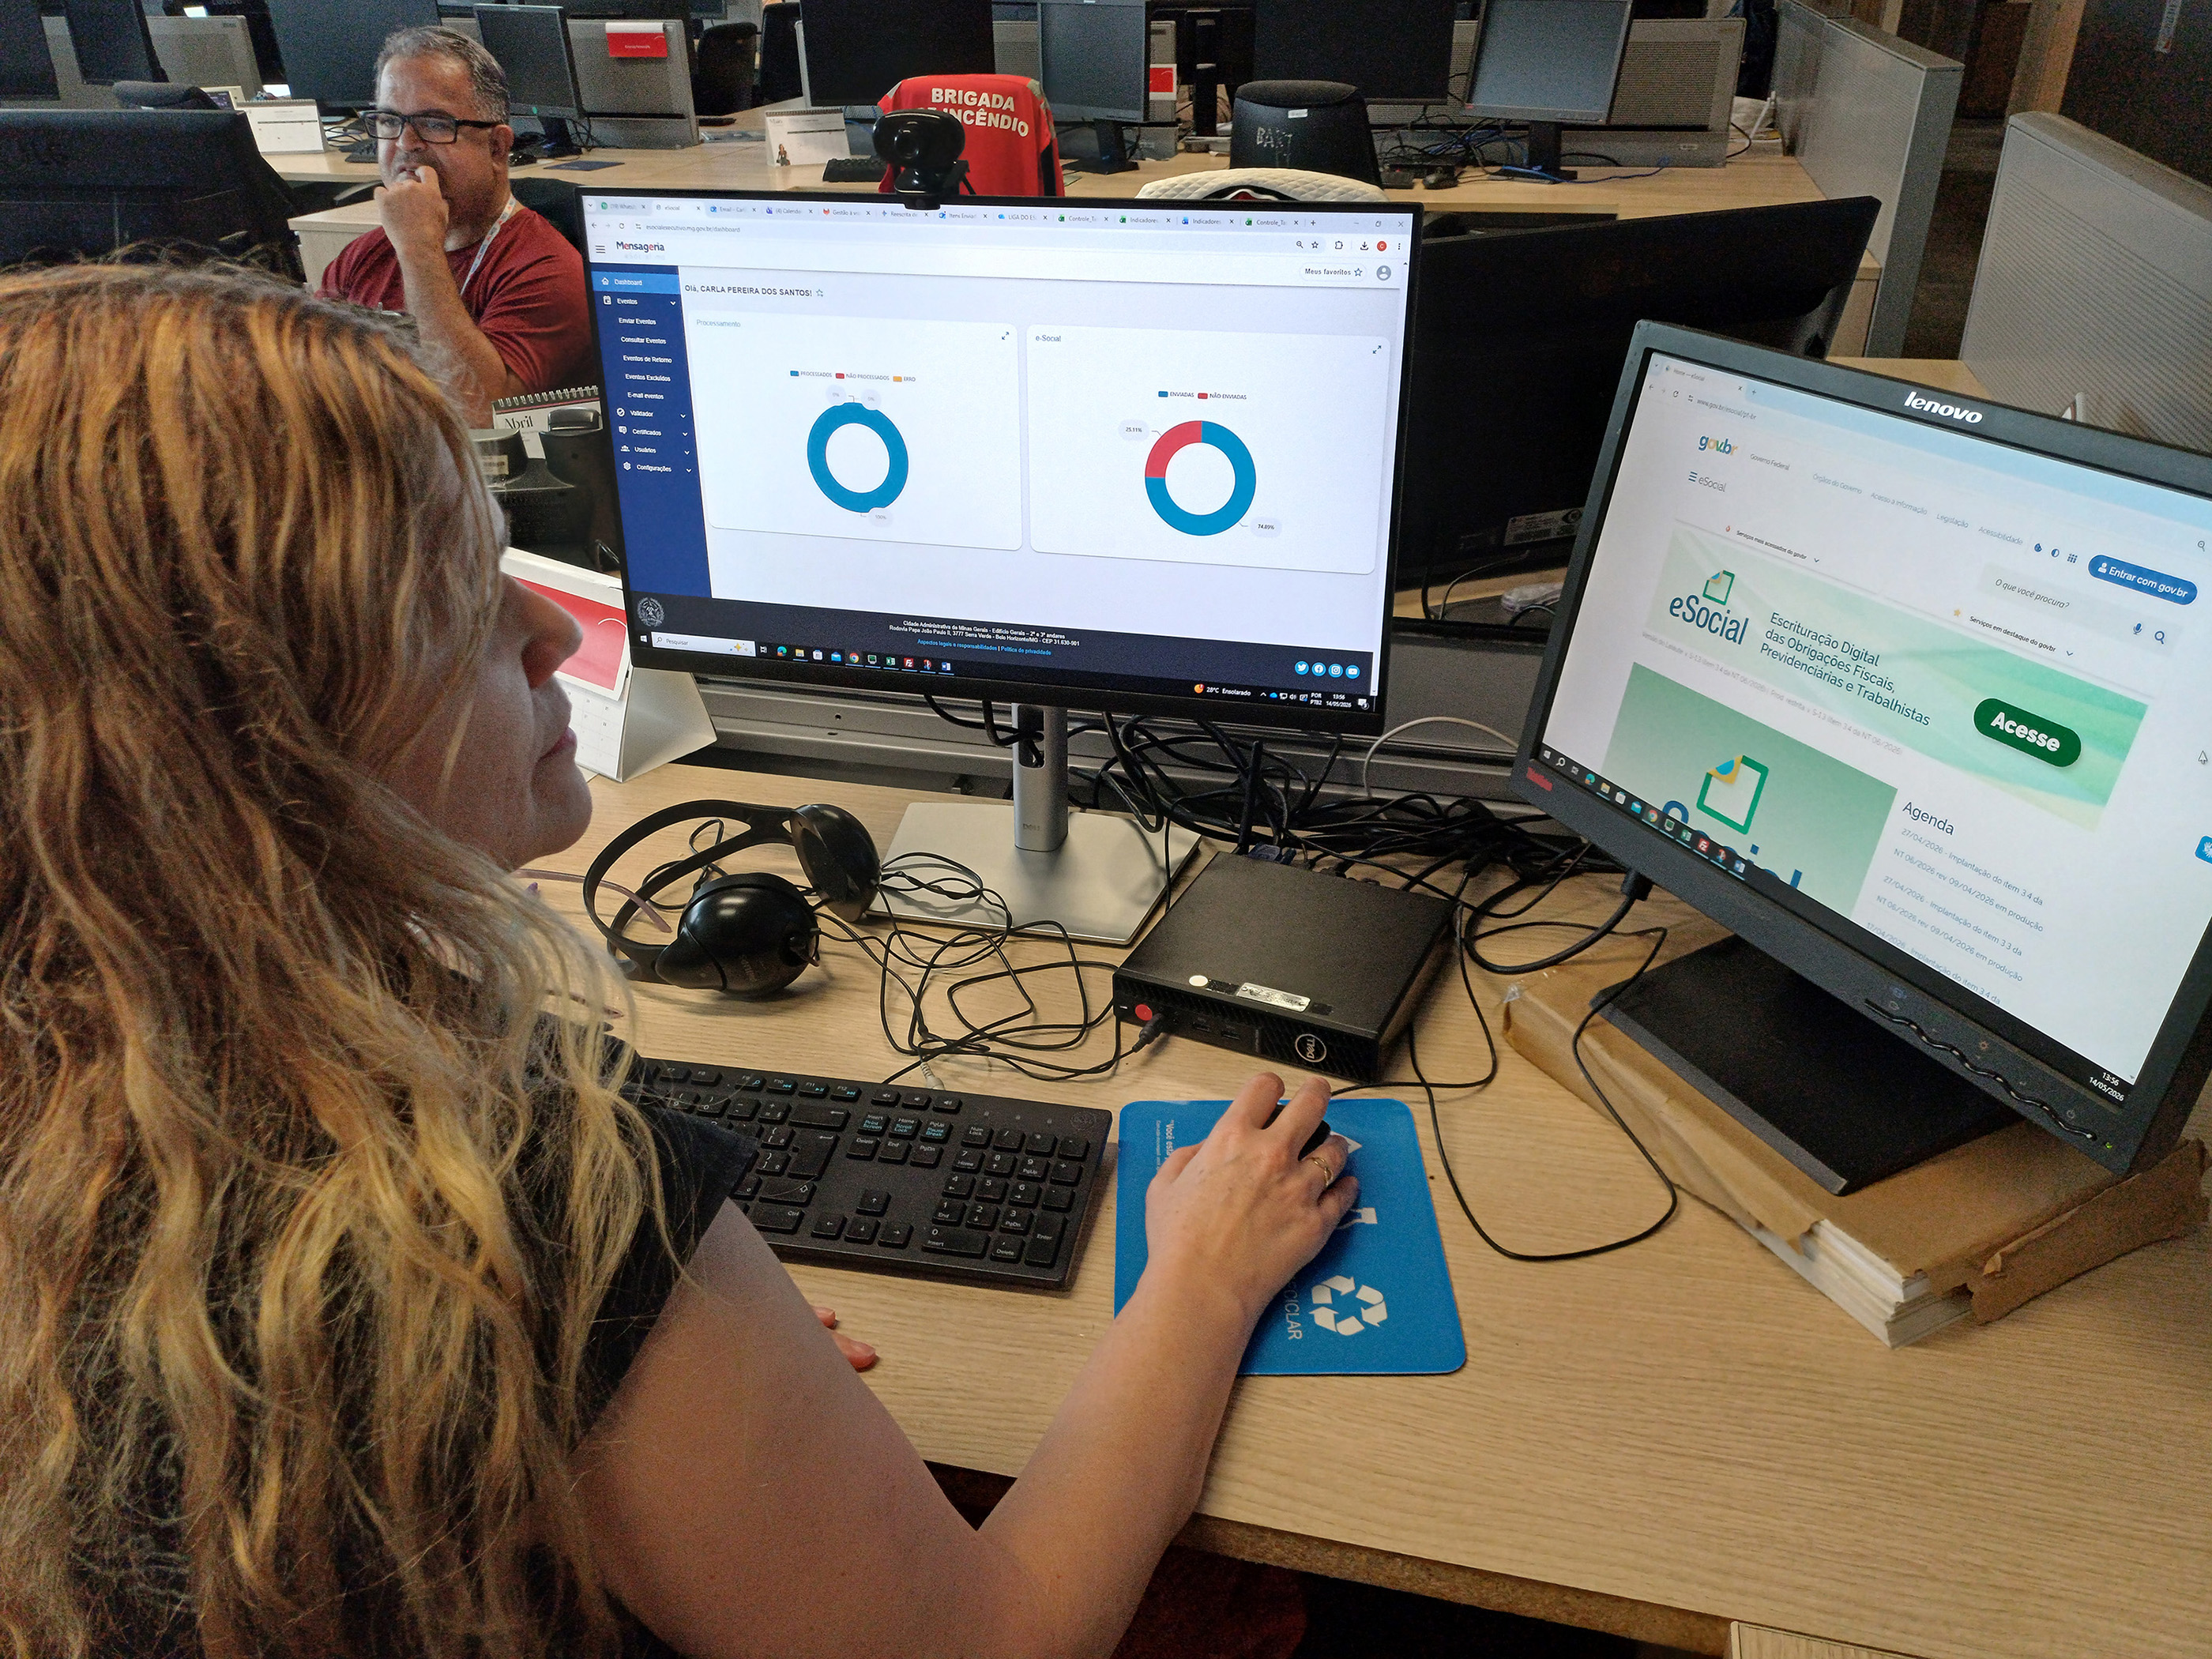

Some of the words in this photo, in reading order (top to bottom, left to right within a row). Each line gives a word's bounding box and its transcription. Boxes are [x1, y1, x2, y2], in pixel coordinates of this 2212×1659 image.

[931, 88, 1015, 111] BRIGADA
[943, 107, 1029, 137] NCÊNDIO
[616, 241, 665, 253] Mensageria
[685, 284, 699, 293] Olá,
[727, 286, 760, 295] PEREIRA
[779, 288, 812, 297] SANTOS!
[697, 319, 741, 328] Processamento
[1904, 391, 1984, 423] lenovo
[1698, 434, 1738, 455] gov.br
[637, 464, 672, 472] Configurações
[1750, 453, 1770, 466] Governo
[1770, 459, 1789, 471] Federal
[1698, 476, 1727, 493] eSocial
[1813, 473, 1831, 487] Órgãos
[1839, 482, 1862, 495] Governo
[1871, 492, 1890, 505] Acesso
[1937, 513, 1969, 529] Legislação
[1978, 526, 2023, 545] Acessibilidade
[1995, 578, 2002, 587] O
[2003, 582, 2017, 593] que
[2017, 585, 2035, 598] você
[2034, 592, 2070, 609] procura?
[2109, 566, 2136, 582] Entrar
[2137, 577, 2157, 589] com
[2157, 581, 2188, 599] gov.br
[1669, 595, 1749, 645] eSocial
[1969, 615, 1992, 630] Serviços
[2003, 626, 2030, 645] destaque
[2030, 637, 2038, 646] do
[1770, 611, 1839, 649] Escrituração
[1841, 641, 1880, 667] Digital
[1765, 629, 1785, 646] das
[1787, 638, 1850, 673] Obrigações
[1853, 665, 1896, 694] Fiscais,
[1760, 642, 1844, 688] Previdenciárias
[1845, 681, 1854, 692] e
[1856, 683, 1932, 727] Trabalhistas
[1861, 732, 1872, 740] NT
[1990, 712, 2061, 752] Acesse
[1902, 801, 1954, 836] Agenda
[1902, 828, 1943, 854] 27/04/2026
[1949, 852, 1991, 878] Implantação
[1992, 875, 2002, 884] do
[2003, 880, 2019, 893] item
[2033, 897, 2043, 905] da
[1894, 848, 1905, 858] NT
[1949, 877, 1994, 906] 09/04/2026
[1995, 903, 2007, 913] em
[2007, 910, 2044, 932] produção
[1883, 875, 1924, 902] 27/04/2026
[1930, 901, 1972, 928] Implantação
[1973, 925, 1982, 935] do
[1983, 930, 1999, 944] item
[2012, 947, 2022, 957] da
[1876, 895, 1887, 905] NT
[1930, 925, 1975, 955] 09/04/2026
[1975, 951, 1987, 961] em
[1988, 958, 2023, 982] produção
[1952, 973, 1962, 982] do
[1962, 978, 1978, 993] item
[1306, 1038, 1315, 1059] DELL
[2090, 1077, 2124, 1102] 14/05/2026
[2102, 1072, 2120, 1086] 13:56
